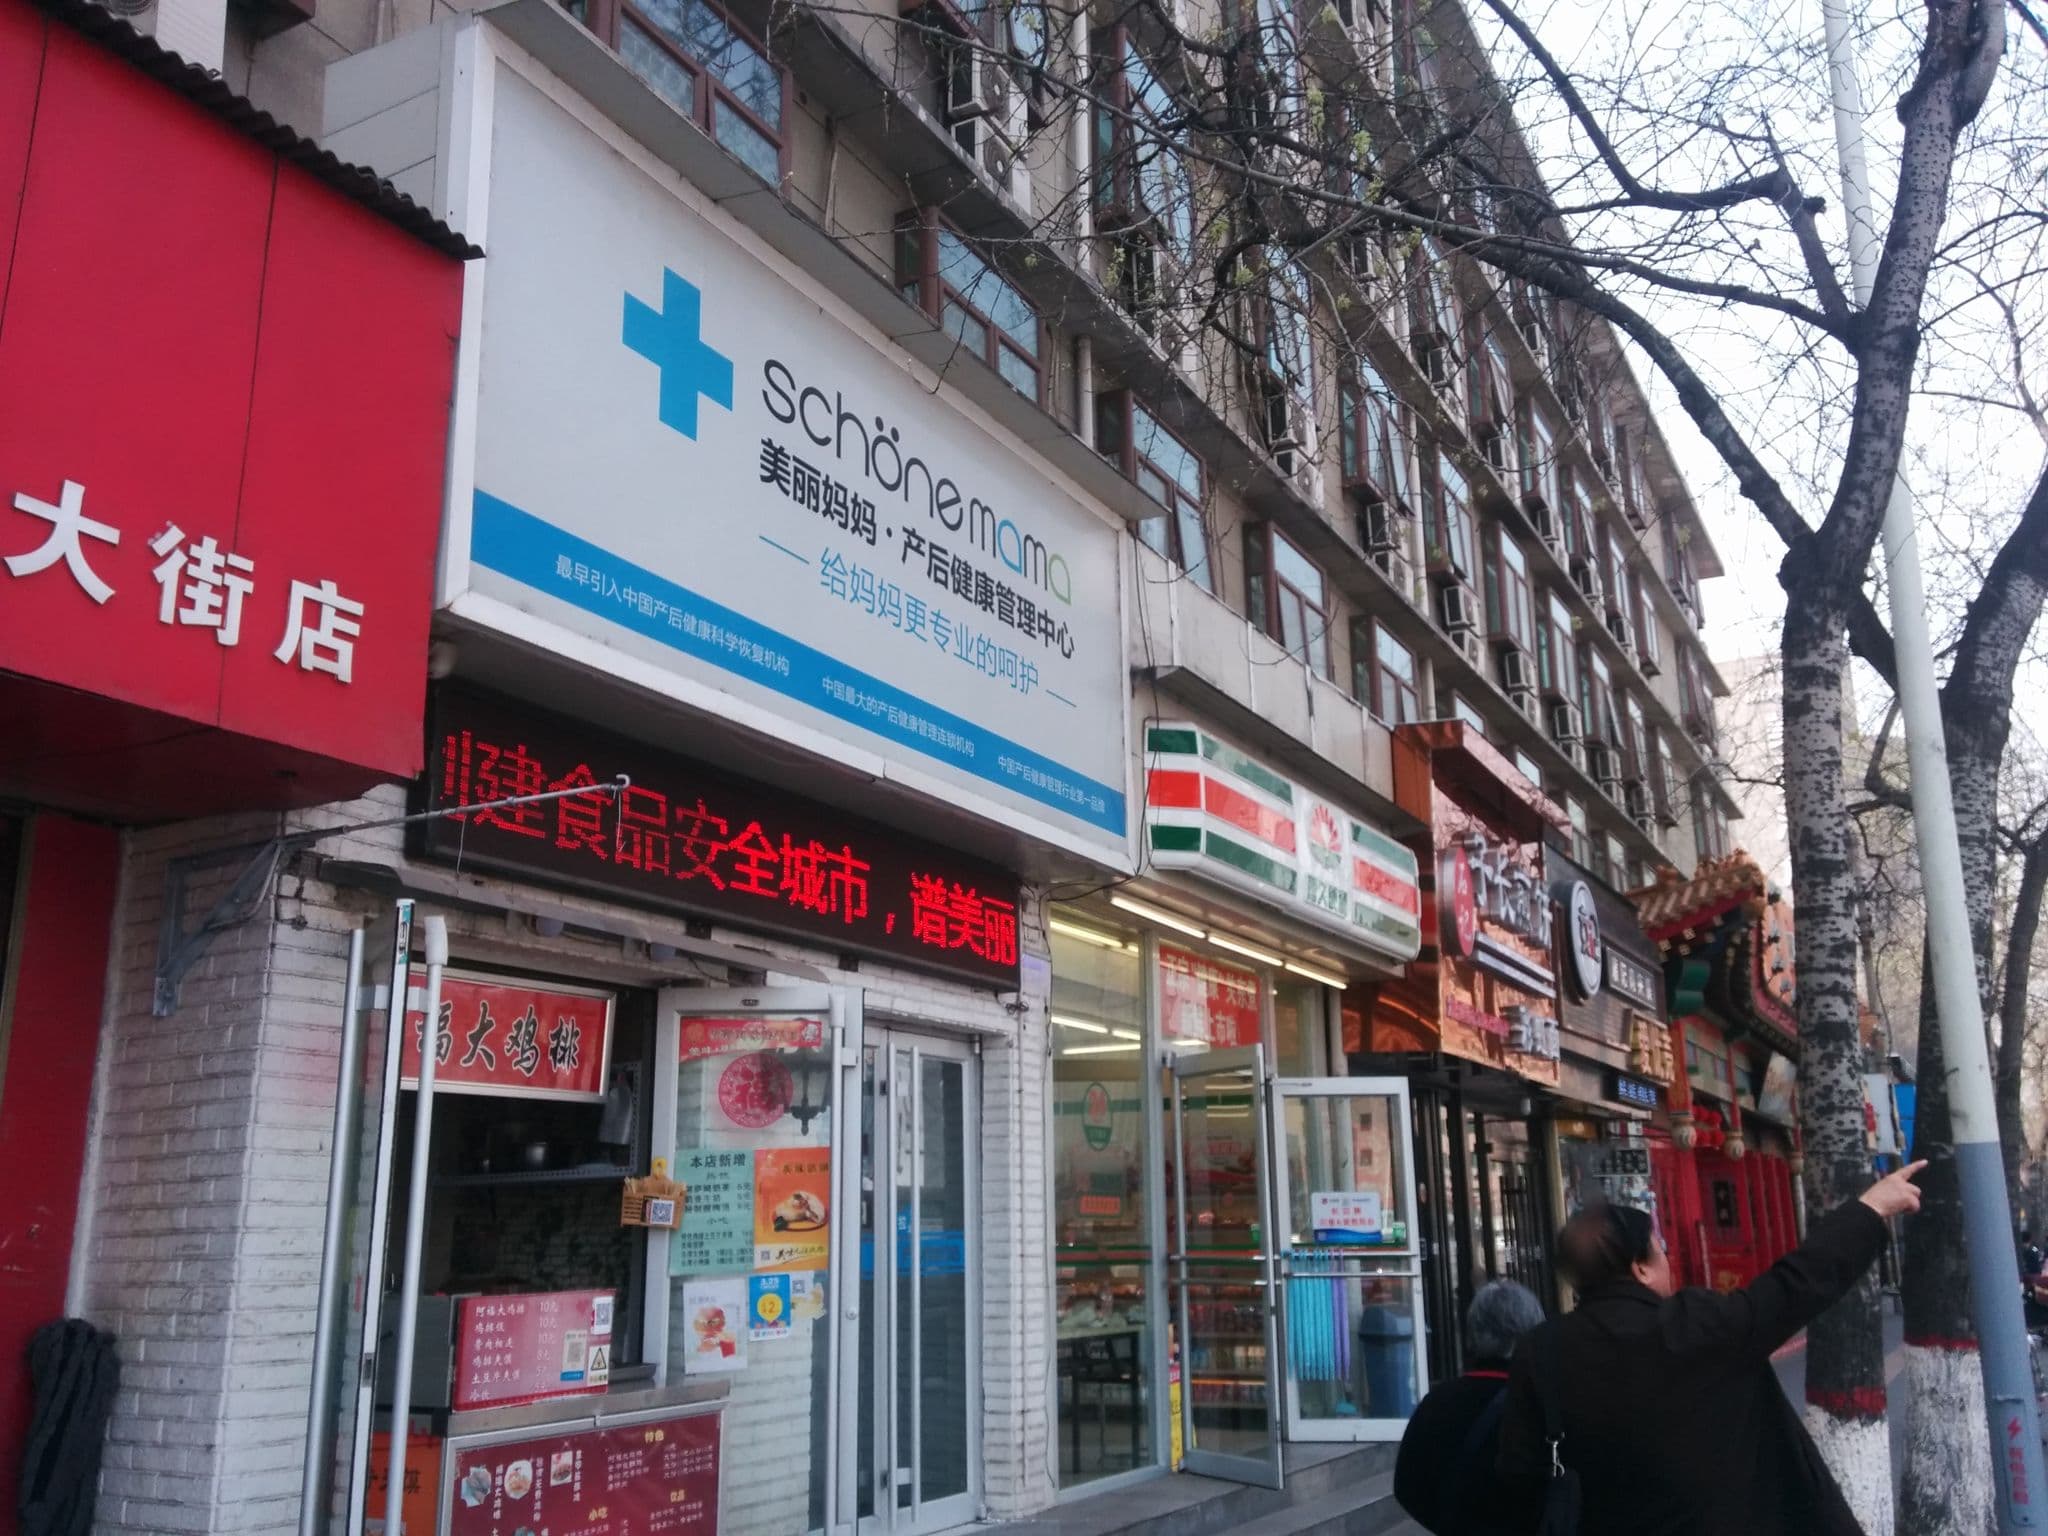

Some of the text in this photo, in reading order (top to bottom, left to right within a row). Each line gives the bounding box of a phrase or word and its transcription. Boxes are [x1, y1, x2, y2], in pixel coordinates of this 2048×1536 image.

[4, 479, 367, 684] 大街店
[555, 553, 790, 677] 最早引入中国产后健康科学恢复机构
[819, 546, 1040, 695] 给妈妈更专业的呵护
[821, 675, 976, 759] 中国最大的产后健康管理连锁机构
[690, 1153, 746, 1168] 本店新增
